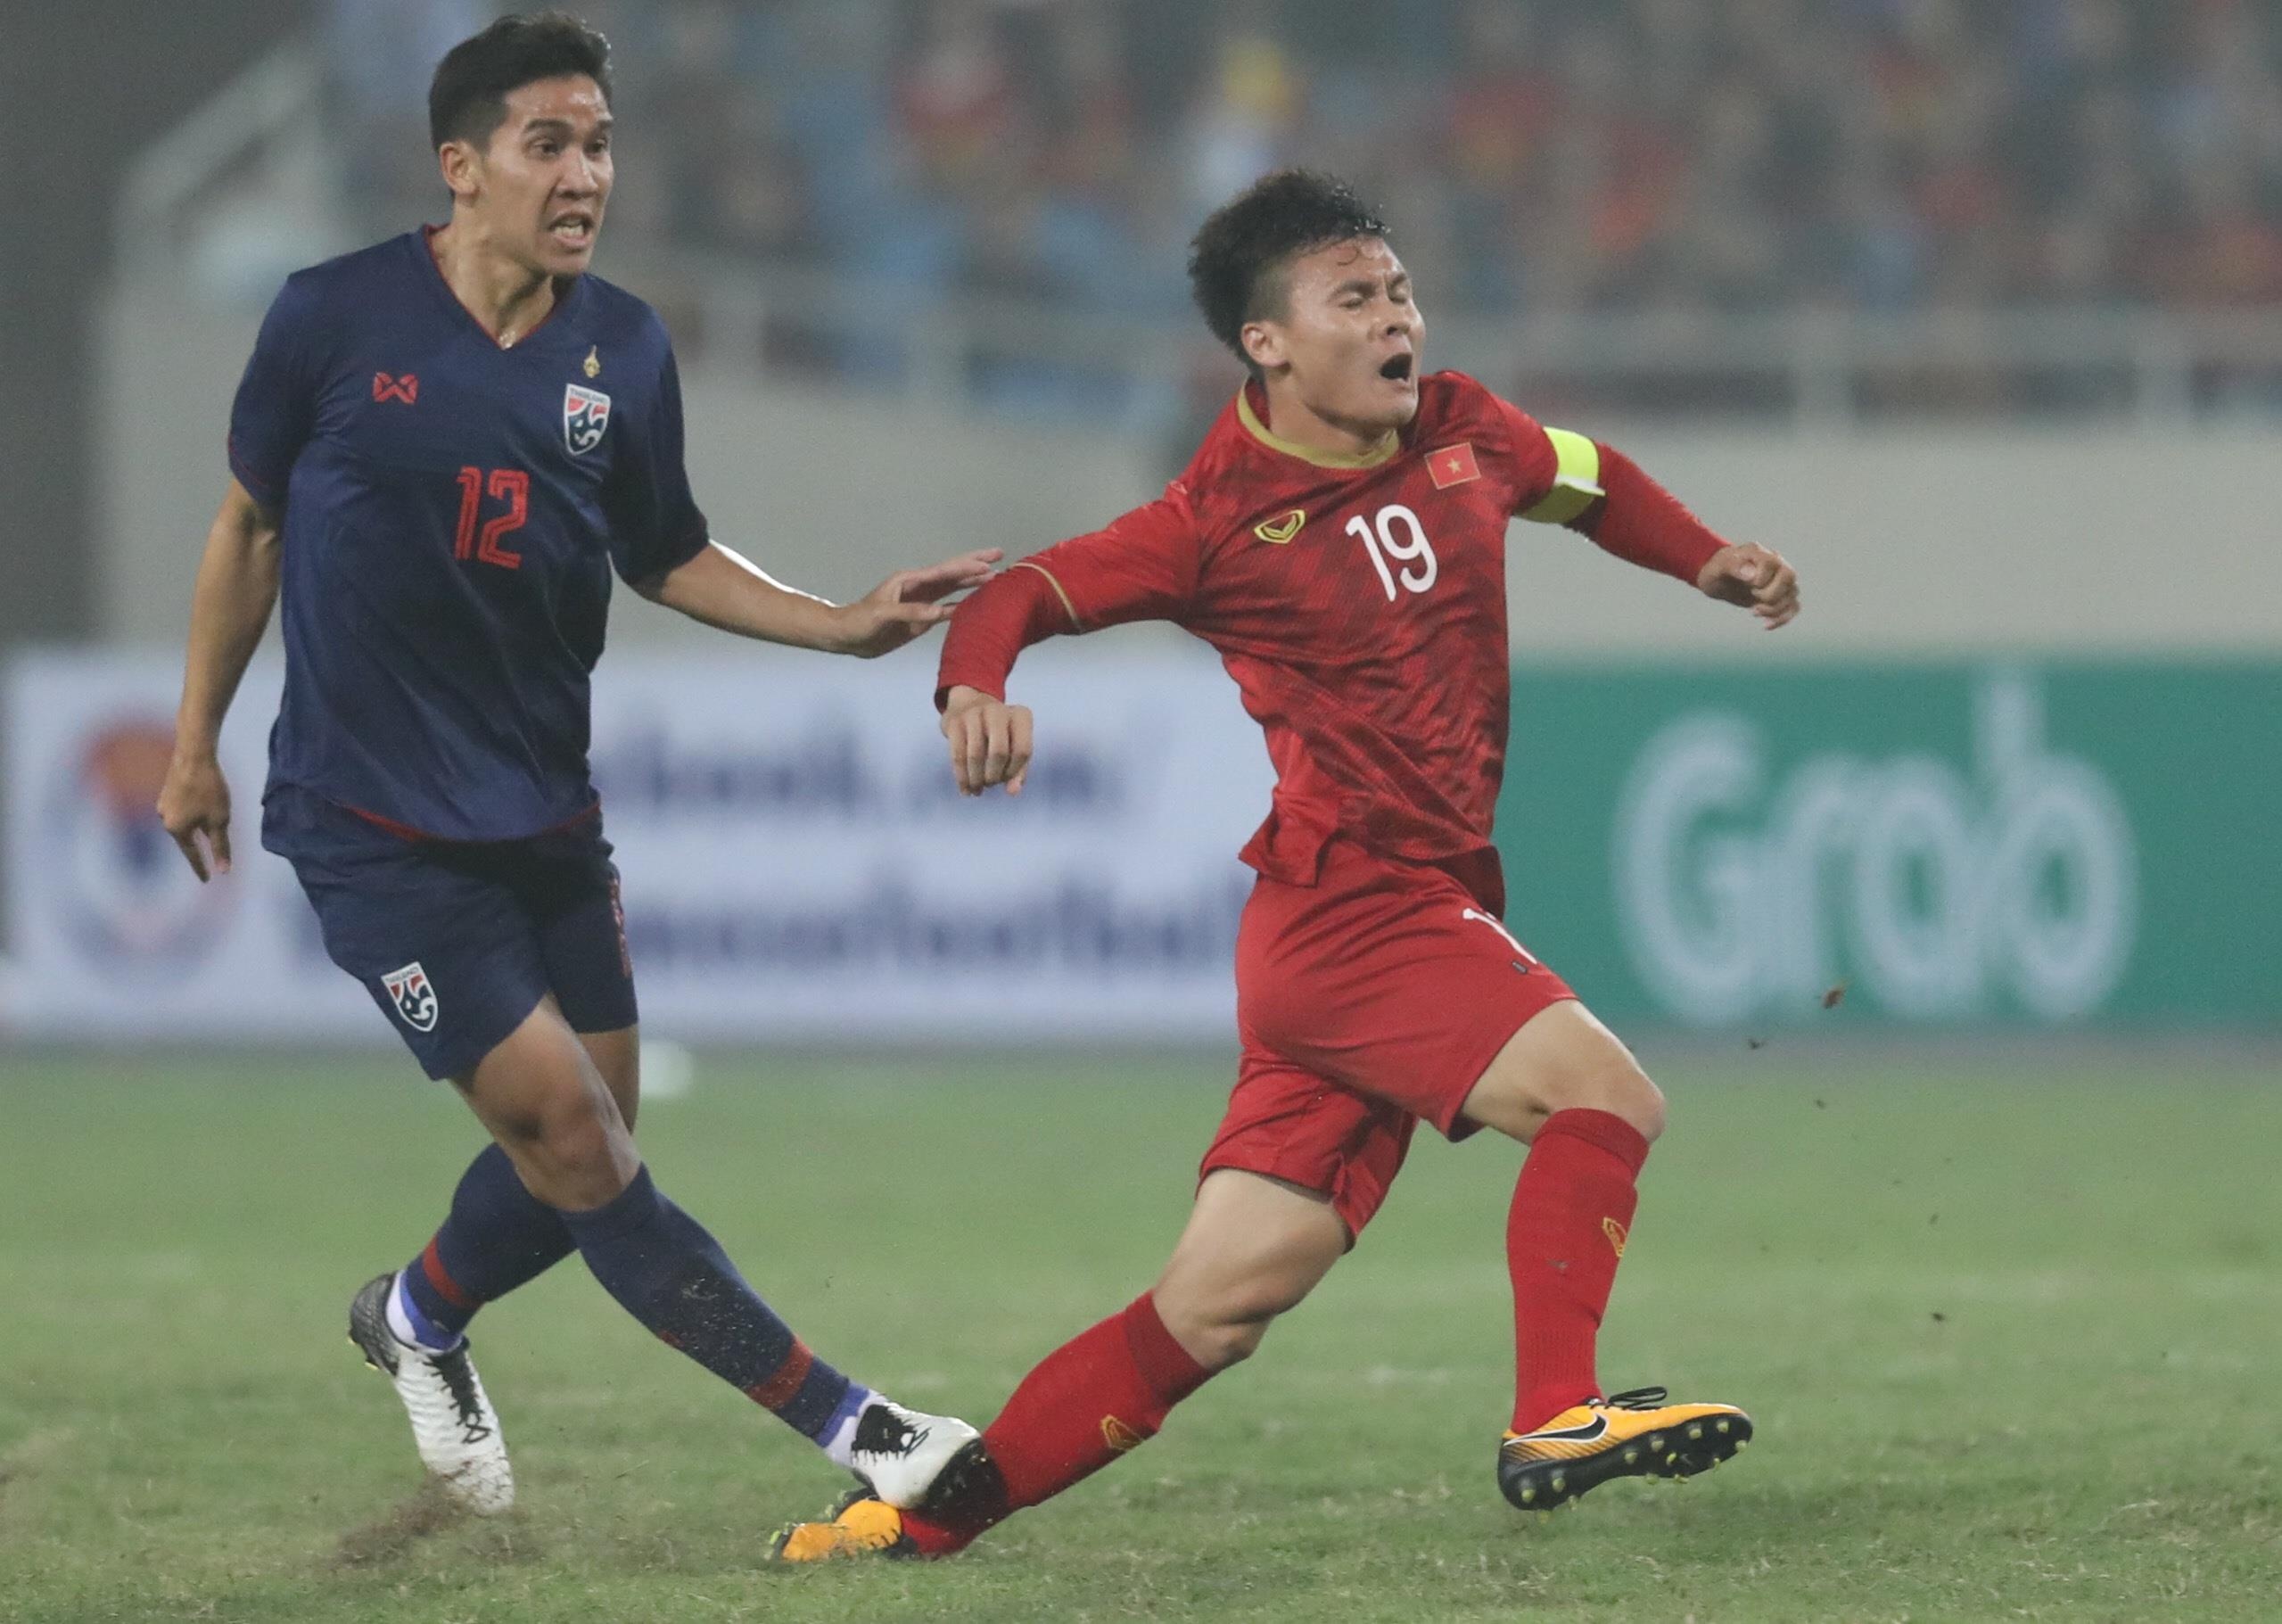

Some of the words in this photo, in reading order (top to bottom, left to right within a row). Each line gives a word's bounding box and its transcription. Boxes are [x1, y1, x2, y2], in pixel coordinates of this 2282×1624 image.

[455, 466, 530, 569] 12
[1345, 504, 1438, 602] 19
[1619, 671, 2133, 1019] Grab
